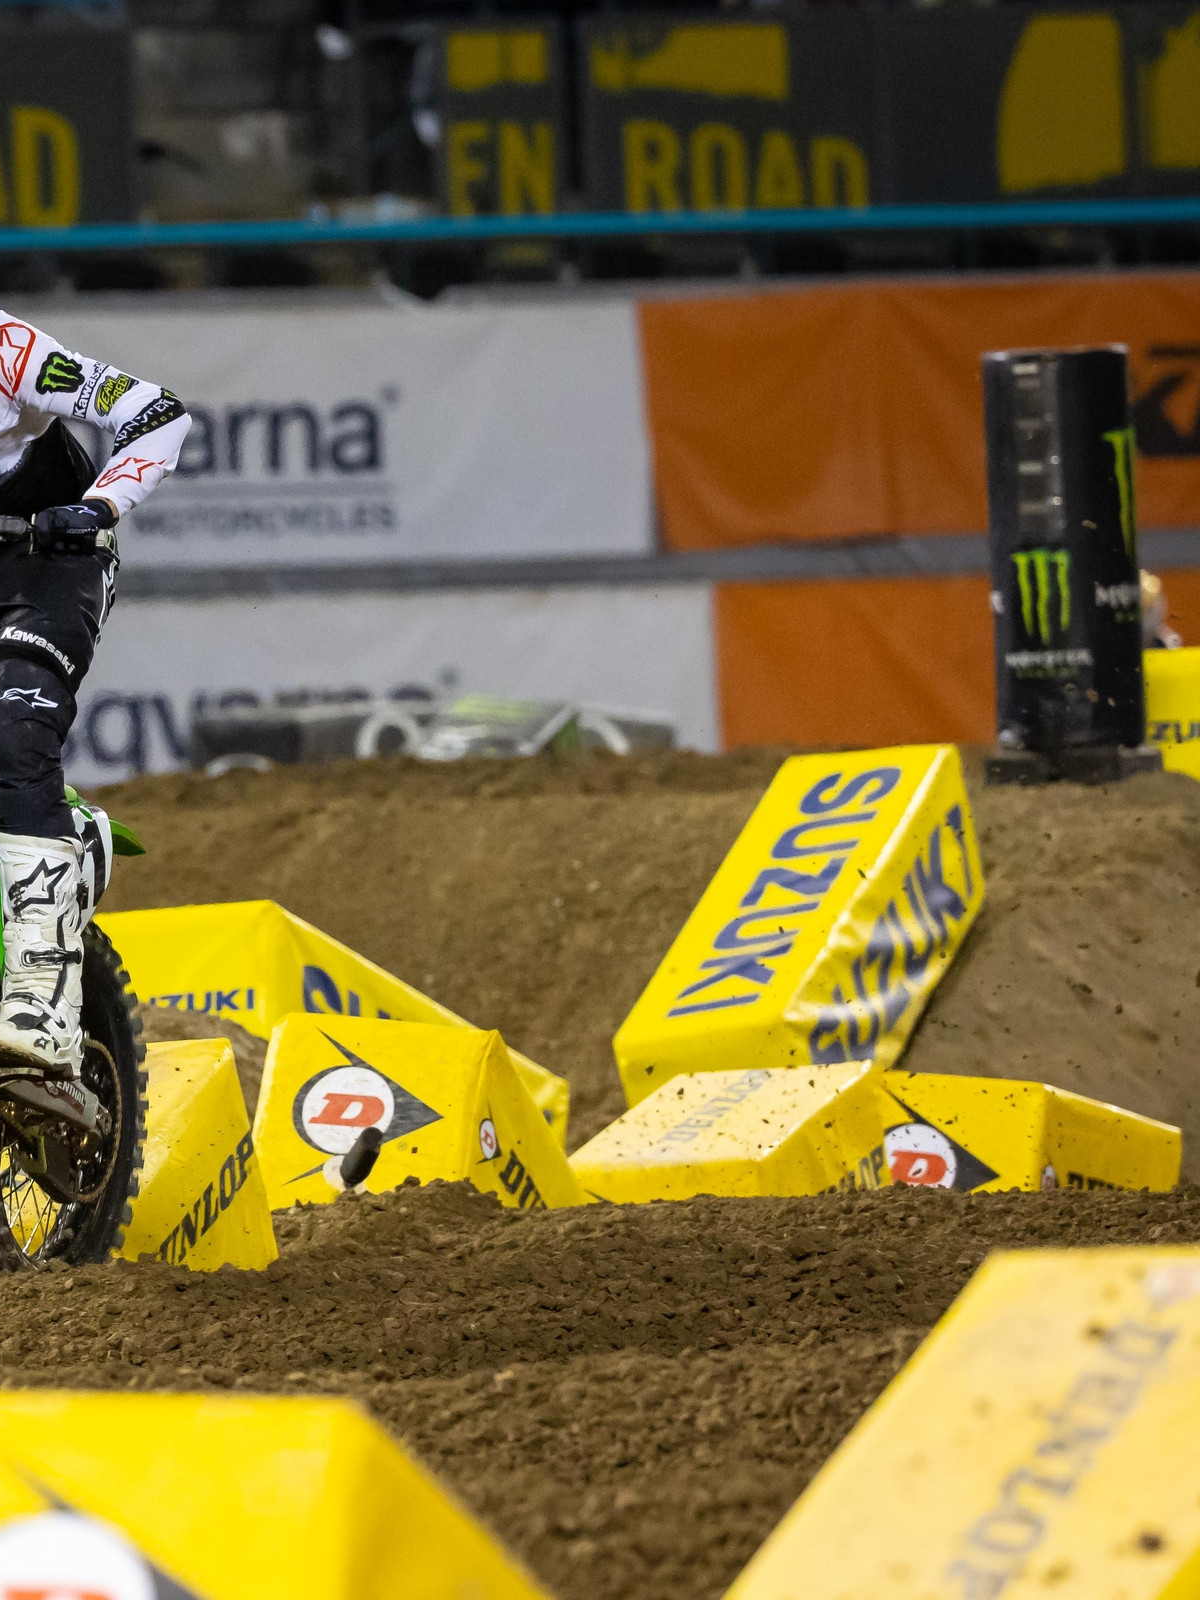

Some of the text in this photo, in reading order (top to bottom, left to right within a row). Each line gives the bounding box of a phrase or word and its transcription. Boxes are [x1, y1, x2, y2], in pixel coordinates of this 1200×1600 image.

[0, 626, 76, 676] Kawasaki
[666, 766, 903, 1018] SUZUKI
[149, 988, 255, 1014] ZUKI
[56, 1080, 86, 1107] ENTHAL
[308, 1092, 385, 1128] D
[159, 1130, 255, 1265] UNLOP
